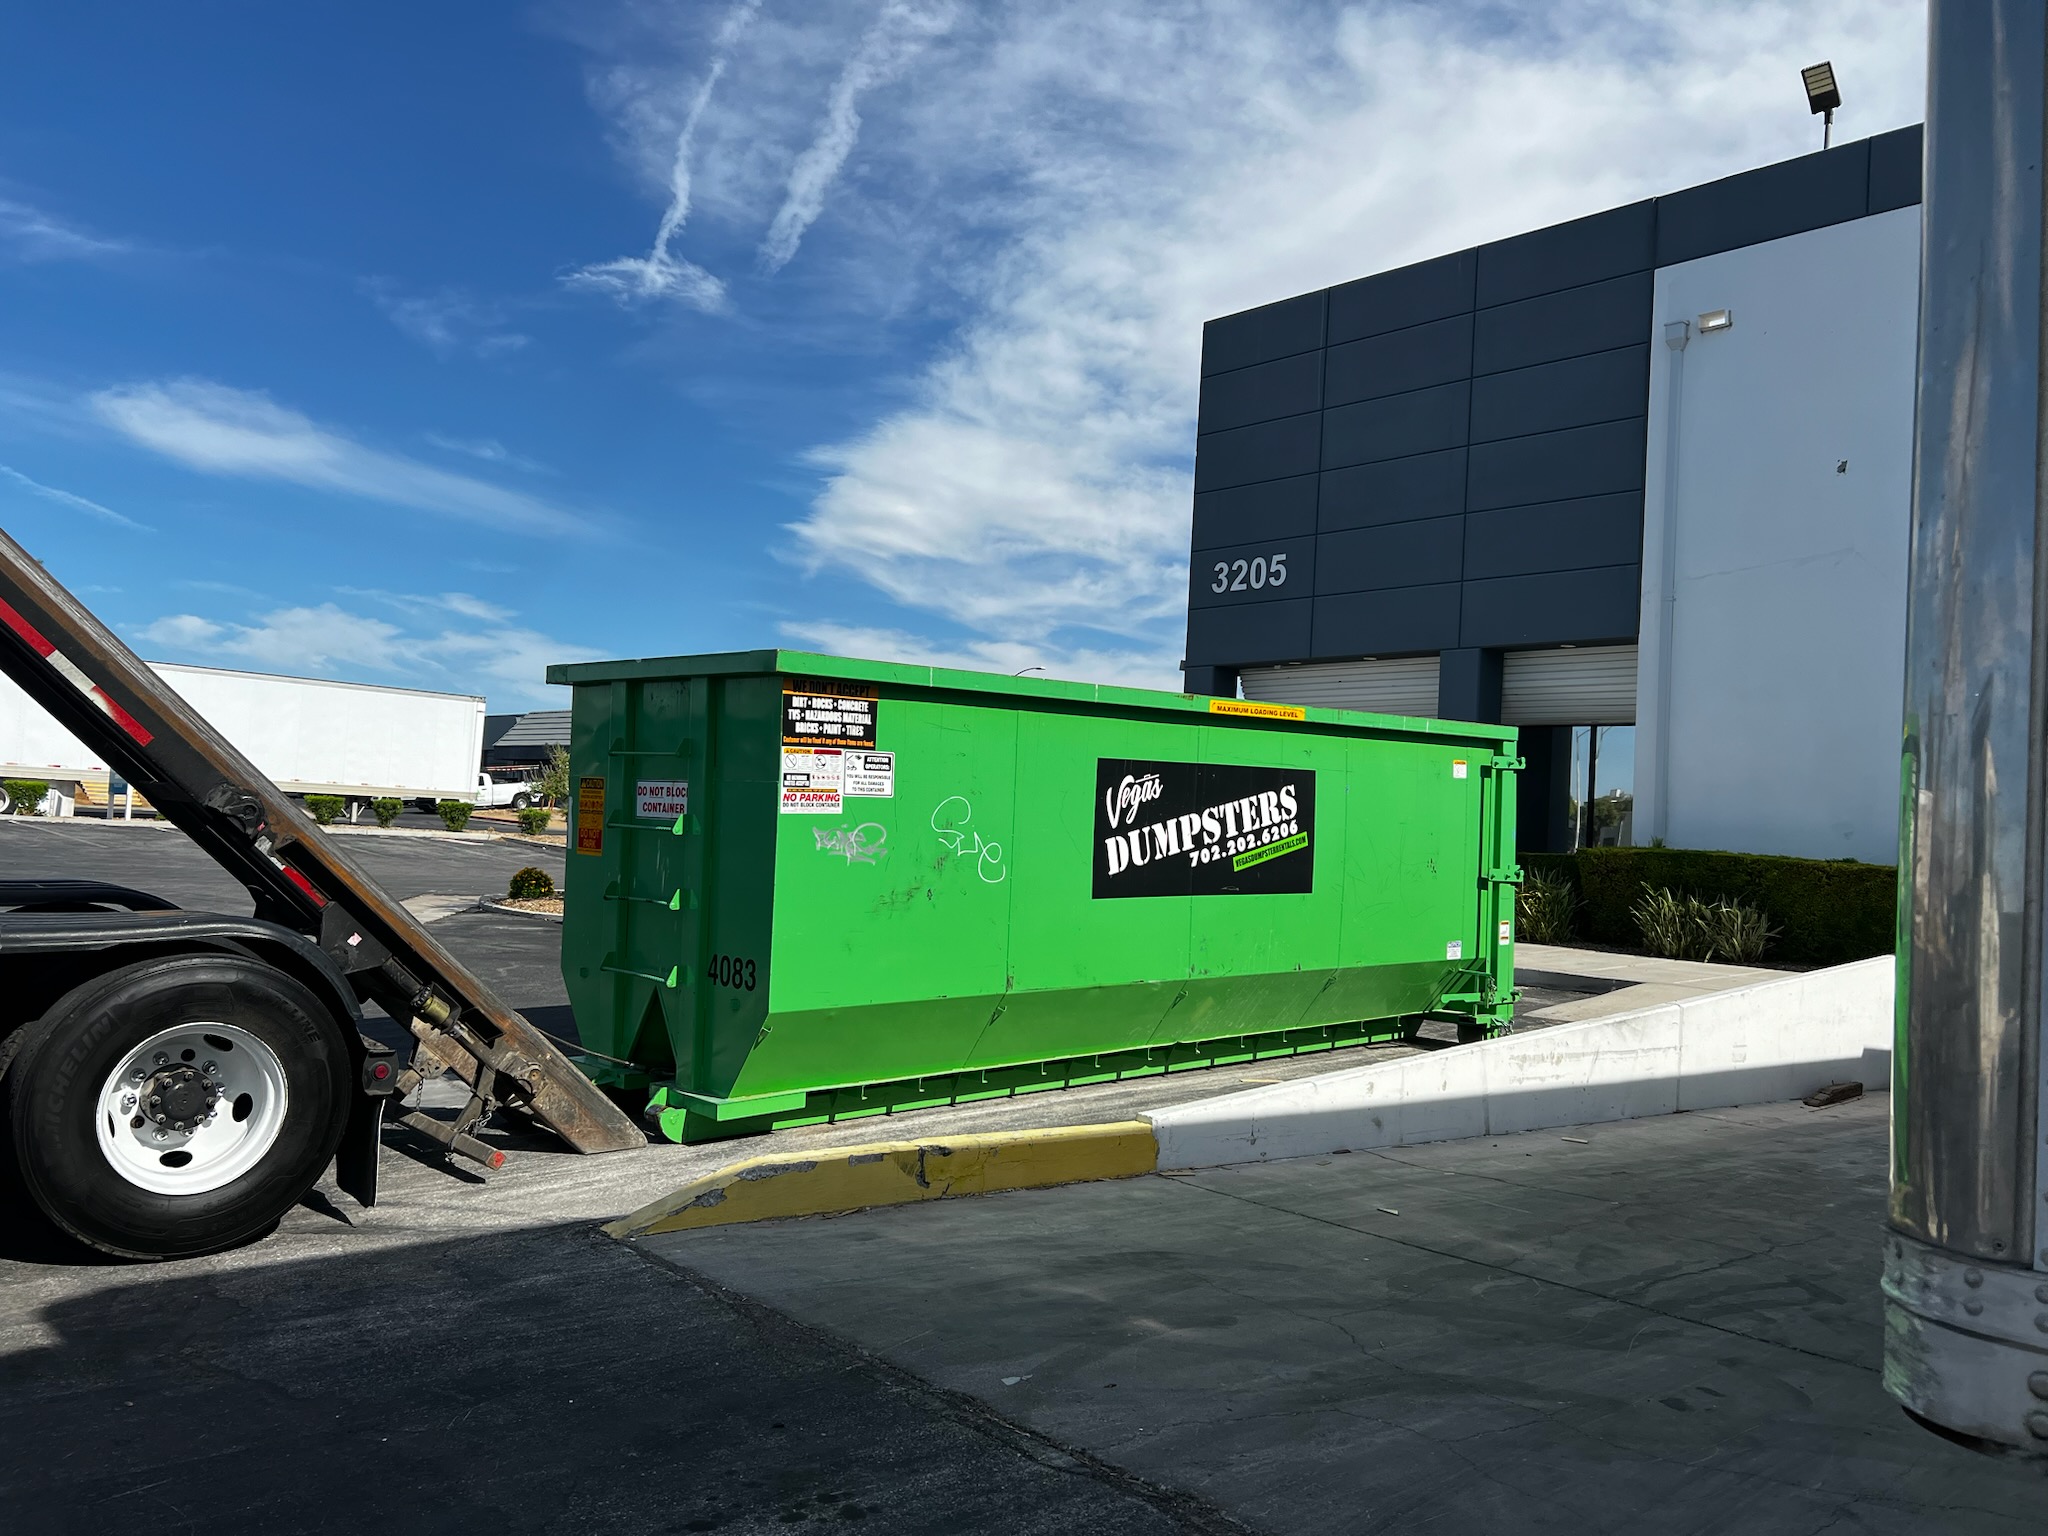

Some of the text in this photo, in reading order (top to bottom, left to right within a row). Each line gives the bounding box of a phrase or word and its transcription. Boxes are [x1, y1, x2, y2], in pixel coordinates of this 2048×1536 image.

[1211, 553, 1287, 594] 3205
[792, 679, 870, 697] WE DON'T ACCEPT
[792, 696, 869, 712] DIRT ROCKS CONCRETE
[1216, 705, 1249, 714] MAXIMUM
[1250, 708, 1278, 717] LOADING
[805, 709, 842, 723] HAZARDOUS
[842, 712, 872, 725] MATERIAL
[795, 721, 864, 737] BRICKS PAINT TIRES
[637, 786, 688, 798] DO NOT BLOC
[783, 793, 840, 802] NO PARKING
[642, 801, 685, 814] CONTAINER
[1106, 773, 1164, 829] Vegas
[1105, 784, 1298, 876] DUMPSTERS
[1190, 818, 1299, 868] 702.202.6206
[1234, 834, 1307, 868] VEGASDUMPSTERRENTALS.COM
[707, 953, 756, 992] 4083
